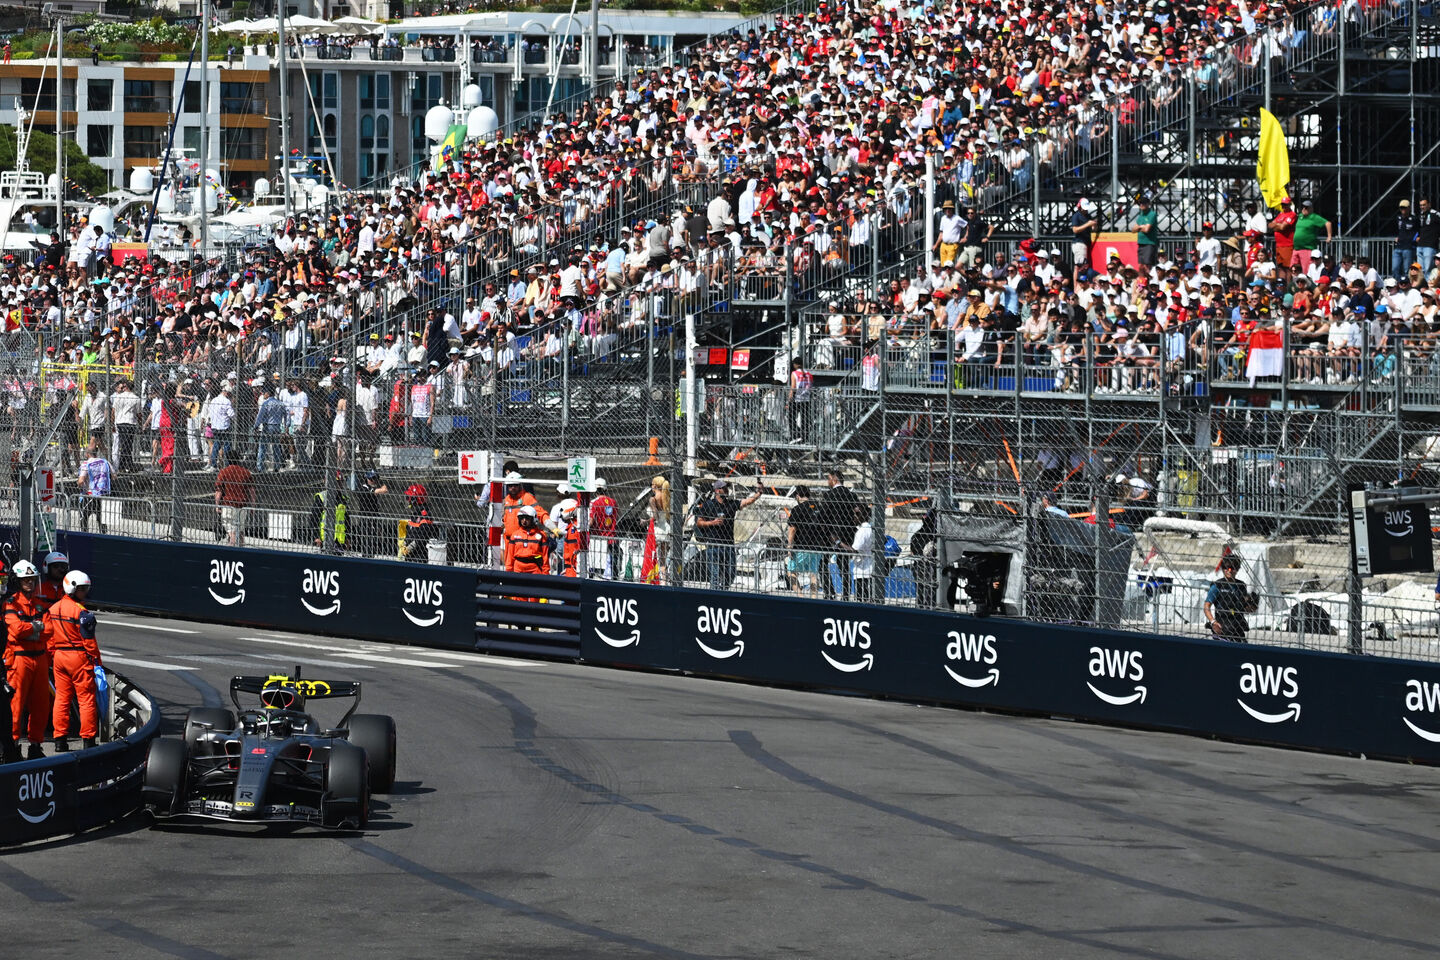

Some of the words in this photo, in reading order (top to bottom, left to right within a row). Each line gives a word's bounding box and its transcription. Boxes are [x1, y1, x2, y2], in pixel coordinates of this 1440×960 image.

[1385, 510, 1411, 525] aws
[210, 560, 244, 585] aws
[303, 569, 339, 595] aws
[404, 578, 442, 606] aws
[597, 597, 638, 625] aws
[698, 606, 742, 636] aws
[824, 618, 871, 649] aws
[947, 631, 997, 664] aws
[1089, 647, 1143, 681] aws
[1240, 663, 1298, 698] aws
[19, 771, 53, 801] aws
